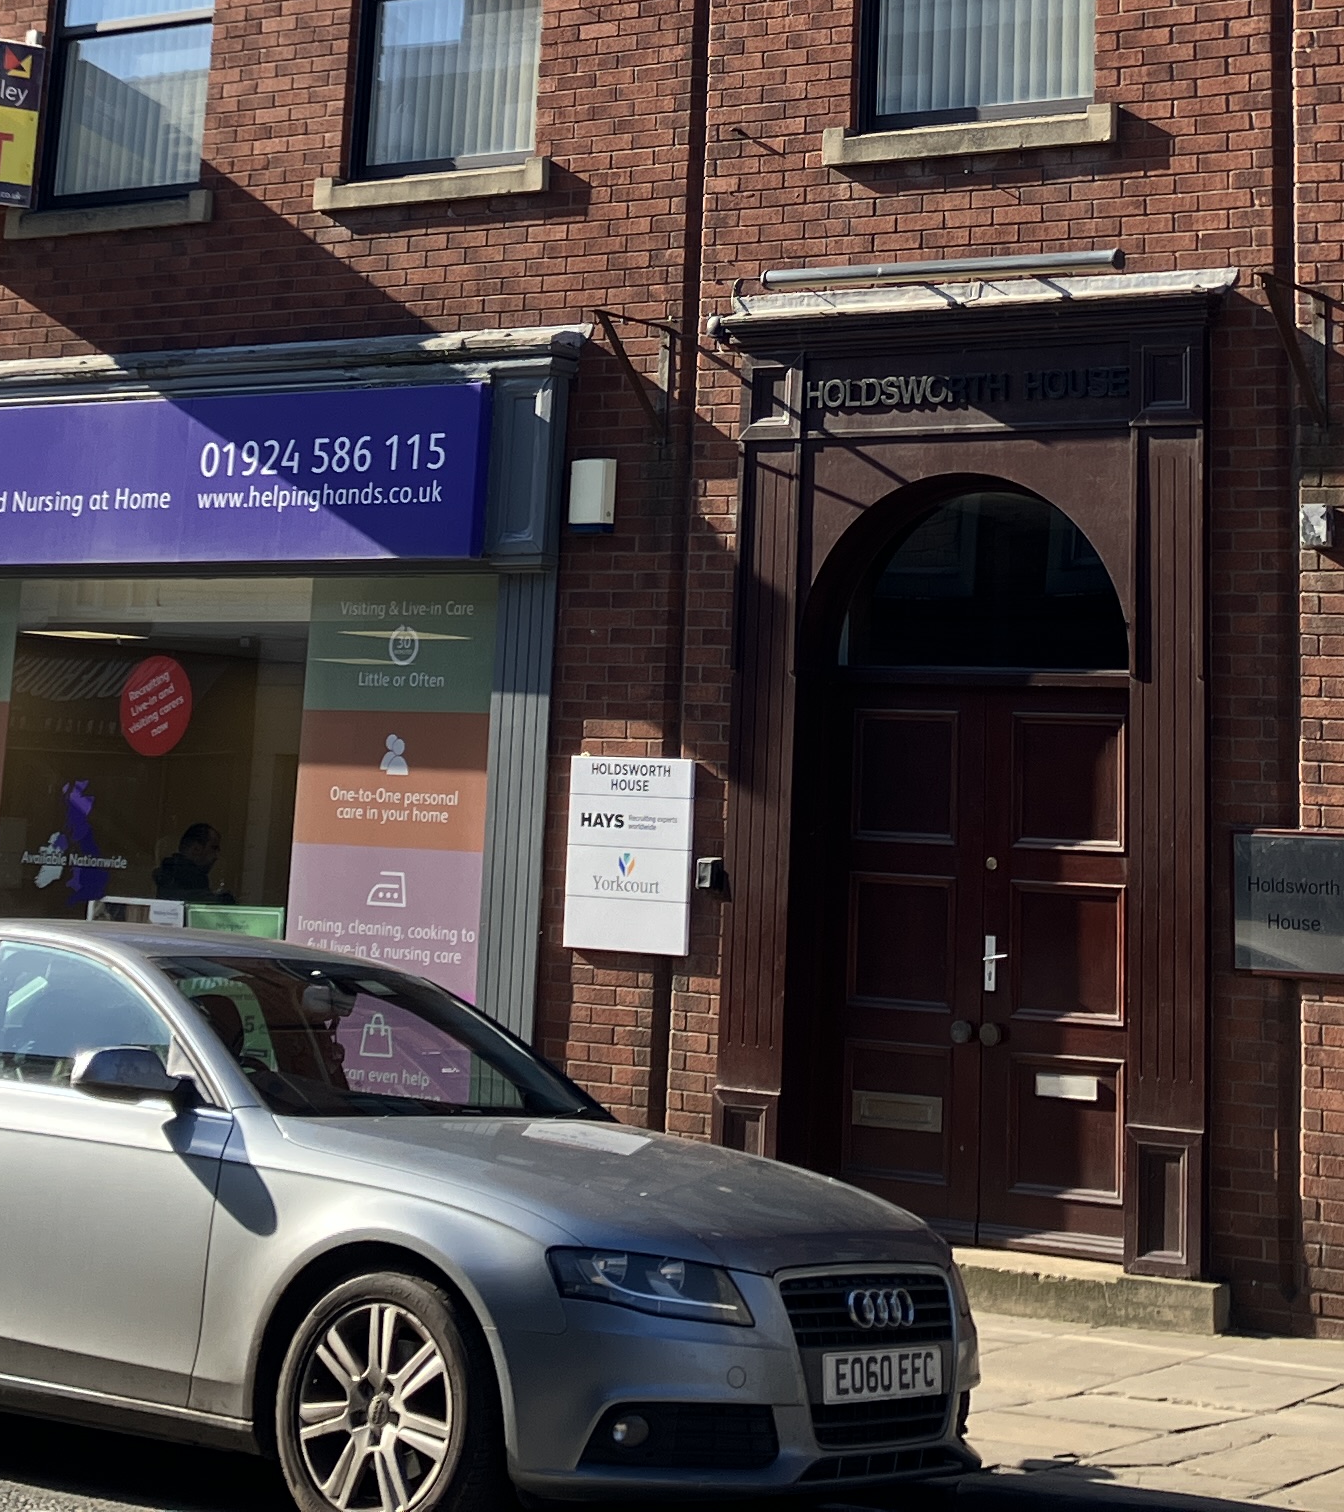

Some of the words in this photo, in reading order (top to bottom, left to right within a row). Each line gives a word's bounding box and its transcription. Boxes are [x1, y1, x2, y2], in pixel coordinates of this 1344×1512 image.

[806, 374, 1006, 409] HOLDSWORTH
[1024, 366, 1131, 402] HOUSE
[199, 439, 300, 478] 01924
[310, 435, 372, 474] 586
[385, 432, 447, 472] 115
[11, 489, 84, 517] Nursing
[88, 490, 109, 510] at
[114, 487, 172, 510] Home
[197, 479, 443, 512] www.helpinghands.co.uk
[340, 601, 386, 619] Visiting
[388, 601, 399, 615] &
[402, 601, 442, 616] Live-in
[445, 601, 474, 616] Care
[396, 636, 412, 649] 30
[128, 671, 170, 701] Recruiting
[358, 671, 390, 687] Little
[392, 675, 407, 687] or
[409, 672, 445, 688] Often
[130, 696, 158, 717] Live-in
[158, 682, 175, 700] and
[128, 711, 159, 734] visiting
[159, 696, 184, 715] carers
[150, 721, 169, 737] now
[591, 762, 672, 778] HOLDSWORTH
[610, 778, 650, 792] HOUSE
[329, 786, 401, 804] One-to-One
[404, 791, 459, 808] personal
[336, 806, 363, 819] care
[366, 805, 378, 820] in
[379, 809, 409, 824] your
[412, 807, 449, 823] home
[581, 812, 624, 829] HAYS
[21, 850, 68, 867] Available
[69, 853, 127, 869] Nationwide
[592, 875, 660, 894] Yorkcourt
[1247, 875, 1340, 896] Holdsworth
[297, 915, 346, 938] Ironing,
[348, 919, 405, 942] cleaning,
[407, 924, 457, 946] cooking
[461, 928, 476, 943] to
[1267, 913, 1321, 932] House
[370, 942, 381, 958] &
[383, 946, 430, 966] nursing
[433, 950, 462, 965] care
[368, 1071, 398, 1084] even
[402, 1068, 430, 1090] help
[899, 1352, 935, 1390] EFC
